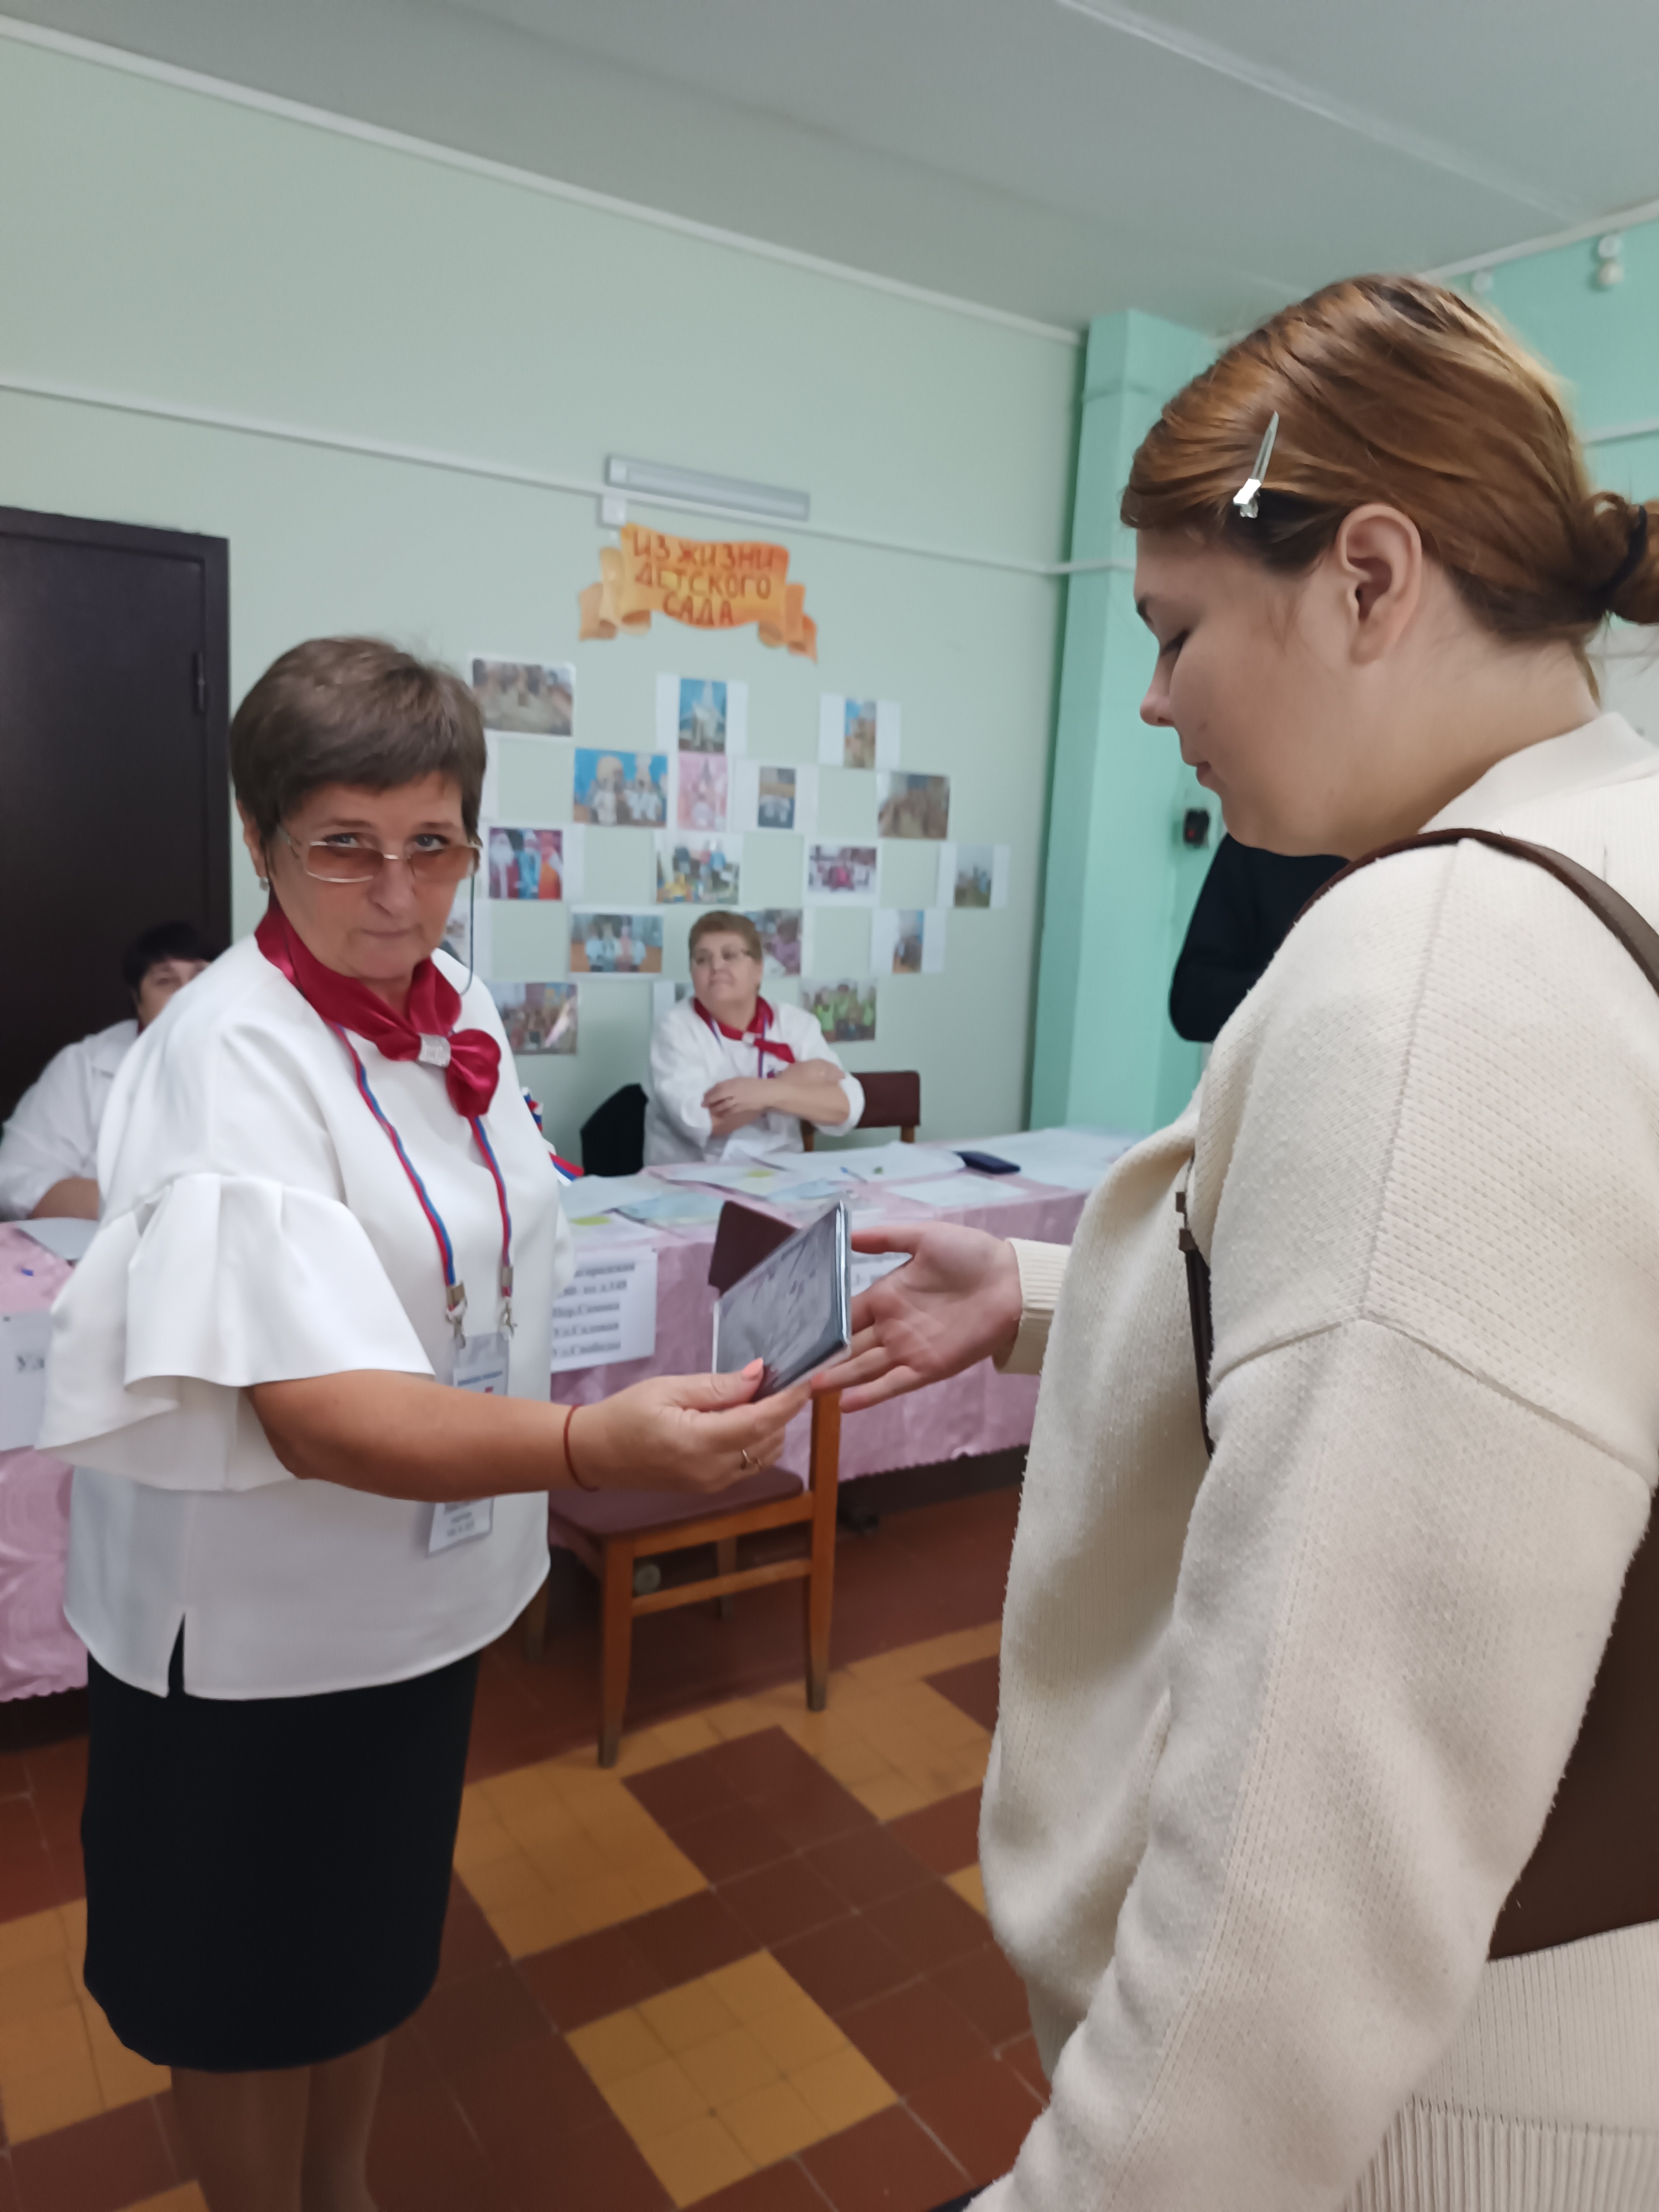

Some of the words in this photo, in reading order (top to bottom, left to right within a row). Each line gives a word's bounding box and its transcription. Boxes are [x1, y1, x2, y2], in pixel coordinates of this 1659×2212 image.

[633, 530, 670, 562] ИЗ
[677, 541, 775, 571] ЖИЗНИ
[635, 561, 772, 600] ДЕТСКОГО
[663, 591, 734, 625] САДА
